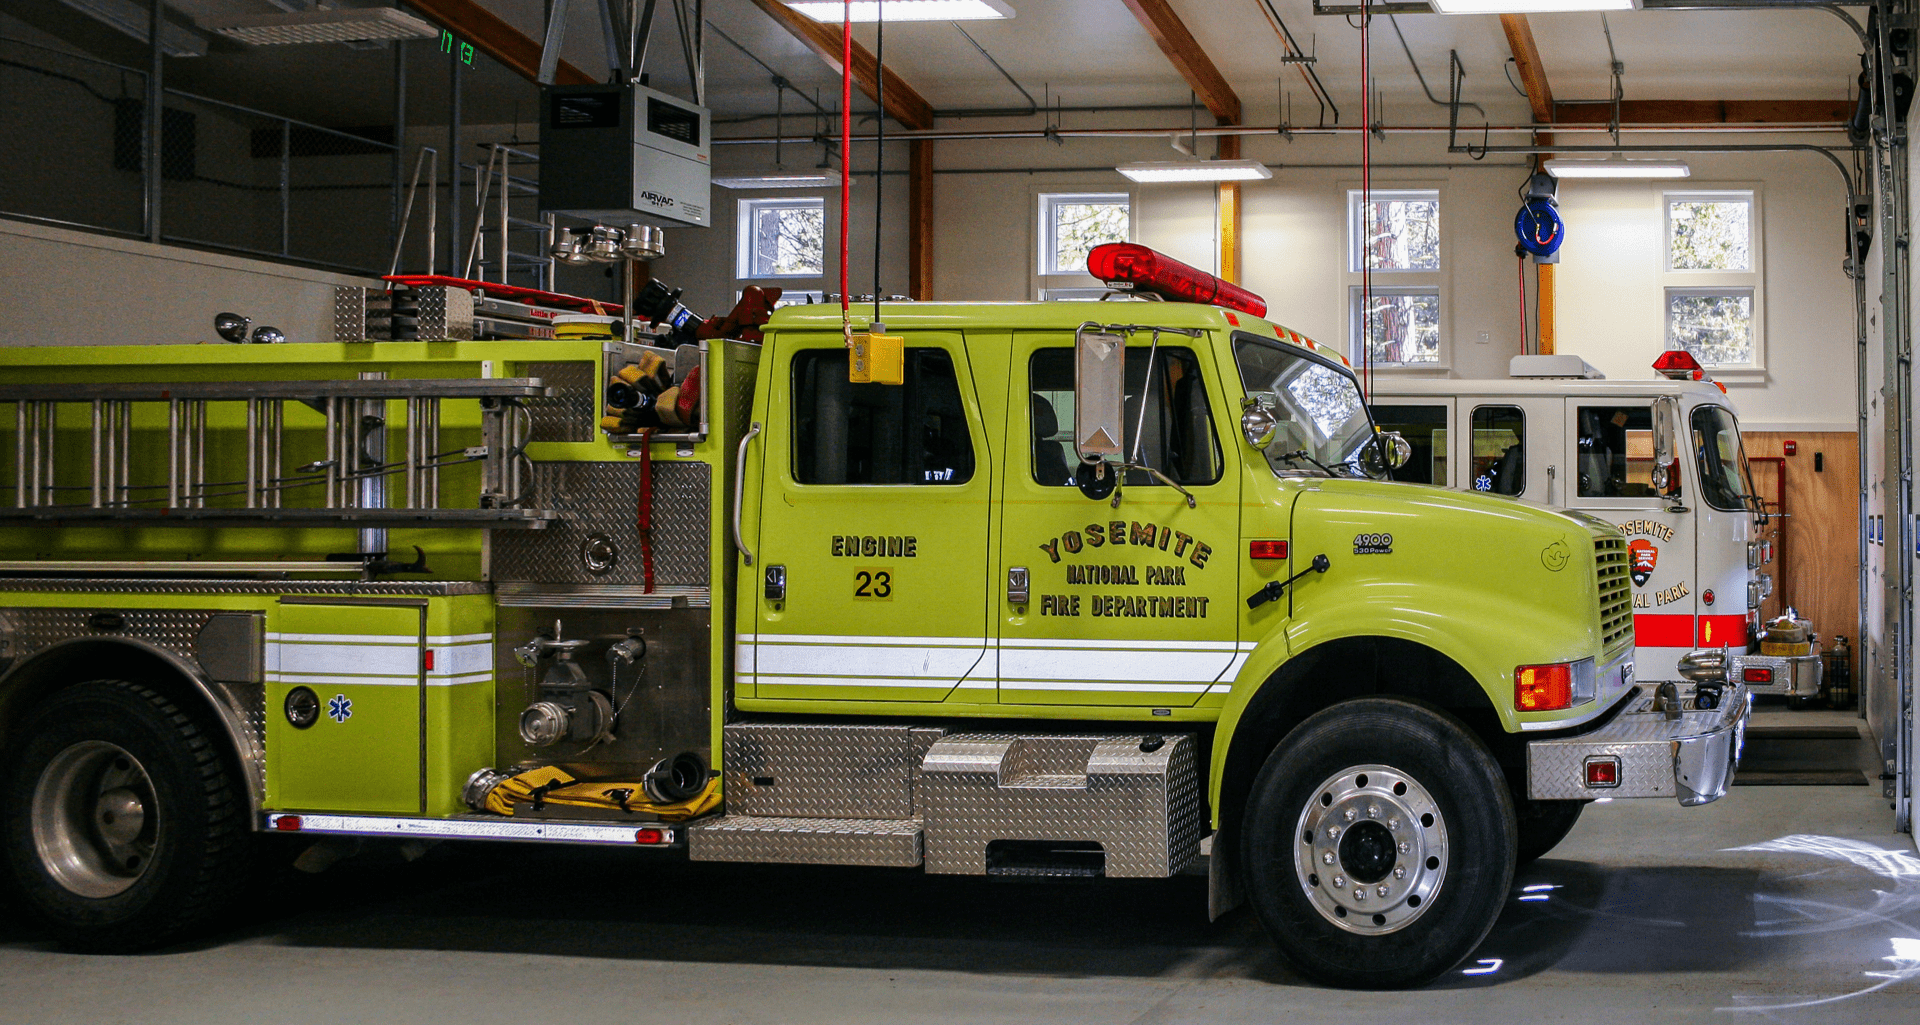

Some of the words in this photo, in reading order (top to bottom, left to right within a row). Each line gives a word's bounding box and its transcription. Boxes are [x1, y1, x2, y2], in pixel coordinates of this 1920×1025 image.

[641, 191, 674, 206] AIRVAC
[530, 308, 548, 318] Little
[1353, 533, 1393, 547] 4900
[1617, 519, 1675, 543] OSEMITE
[831, 535, 917, 557] ENGINE
[1039, 521, 1213, 570] YOSEMITE
[855, 570, 892, 598] 23
[1066, 564, 1139, 584] NATIONAL
[1146, 566, 1186, 585] PARK
[1655, 580, 1690, 606] PARK
[1040, 594, 1080, 616] FIRE
[1091, 595, 1209, 618] DEPARTMENT
